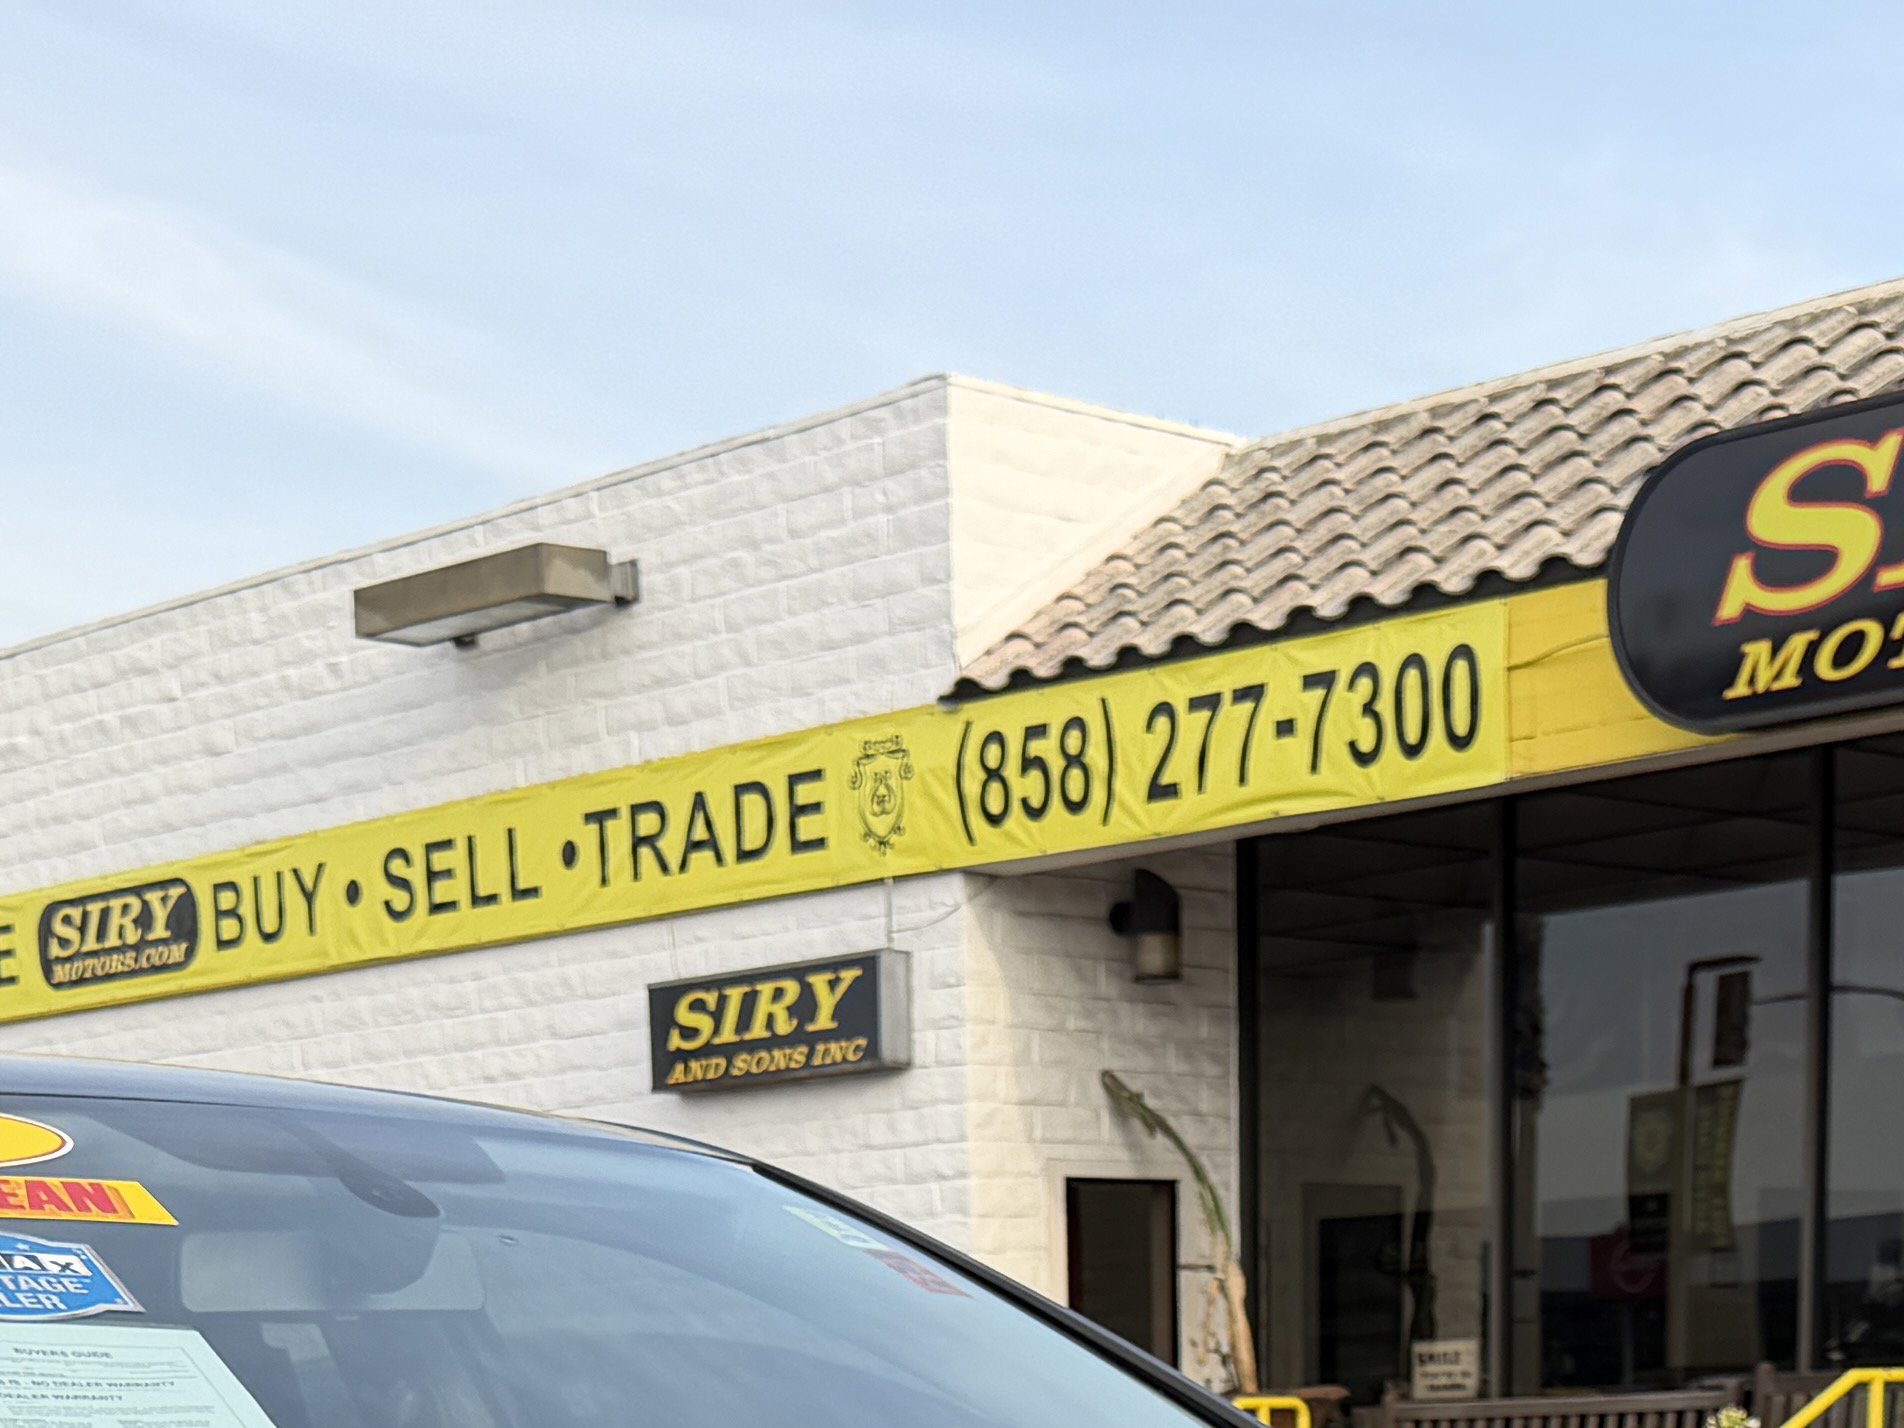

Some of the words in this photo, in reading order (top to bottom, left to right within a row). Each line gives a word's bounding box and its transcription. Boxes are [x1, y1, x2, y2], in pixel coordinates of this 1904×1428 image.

[955, 697, 1115, 847] (858)
[1145, 643, 1481, 804] 277-7300
[213, 862, 326, 951] BUY
[382, 826, 542, 922] SELL
[583, 767, 829, 887] TRADE
[47, 886, 187, 960] SIRY
[50, 942, 189, 984] MOTORS.COM
[666, 966, 864, 1052] SIRY
[665, 1055, 727, 1085] AND
[729, 1045, 809, 1077] SONS
[810, 1036, 868, 1067] INC
